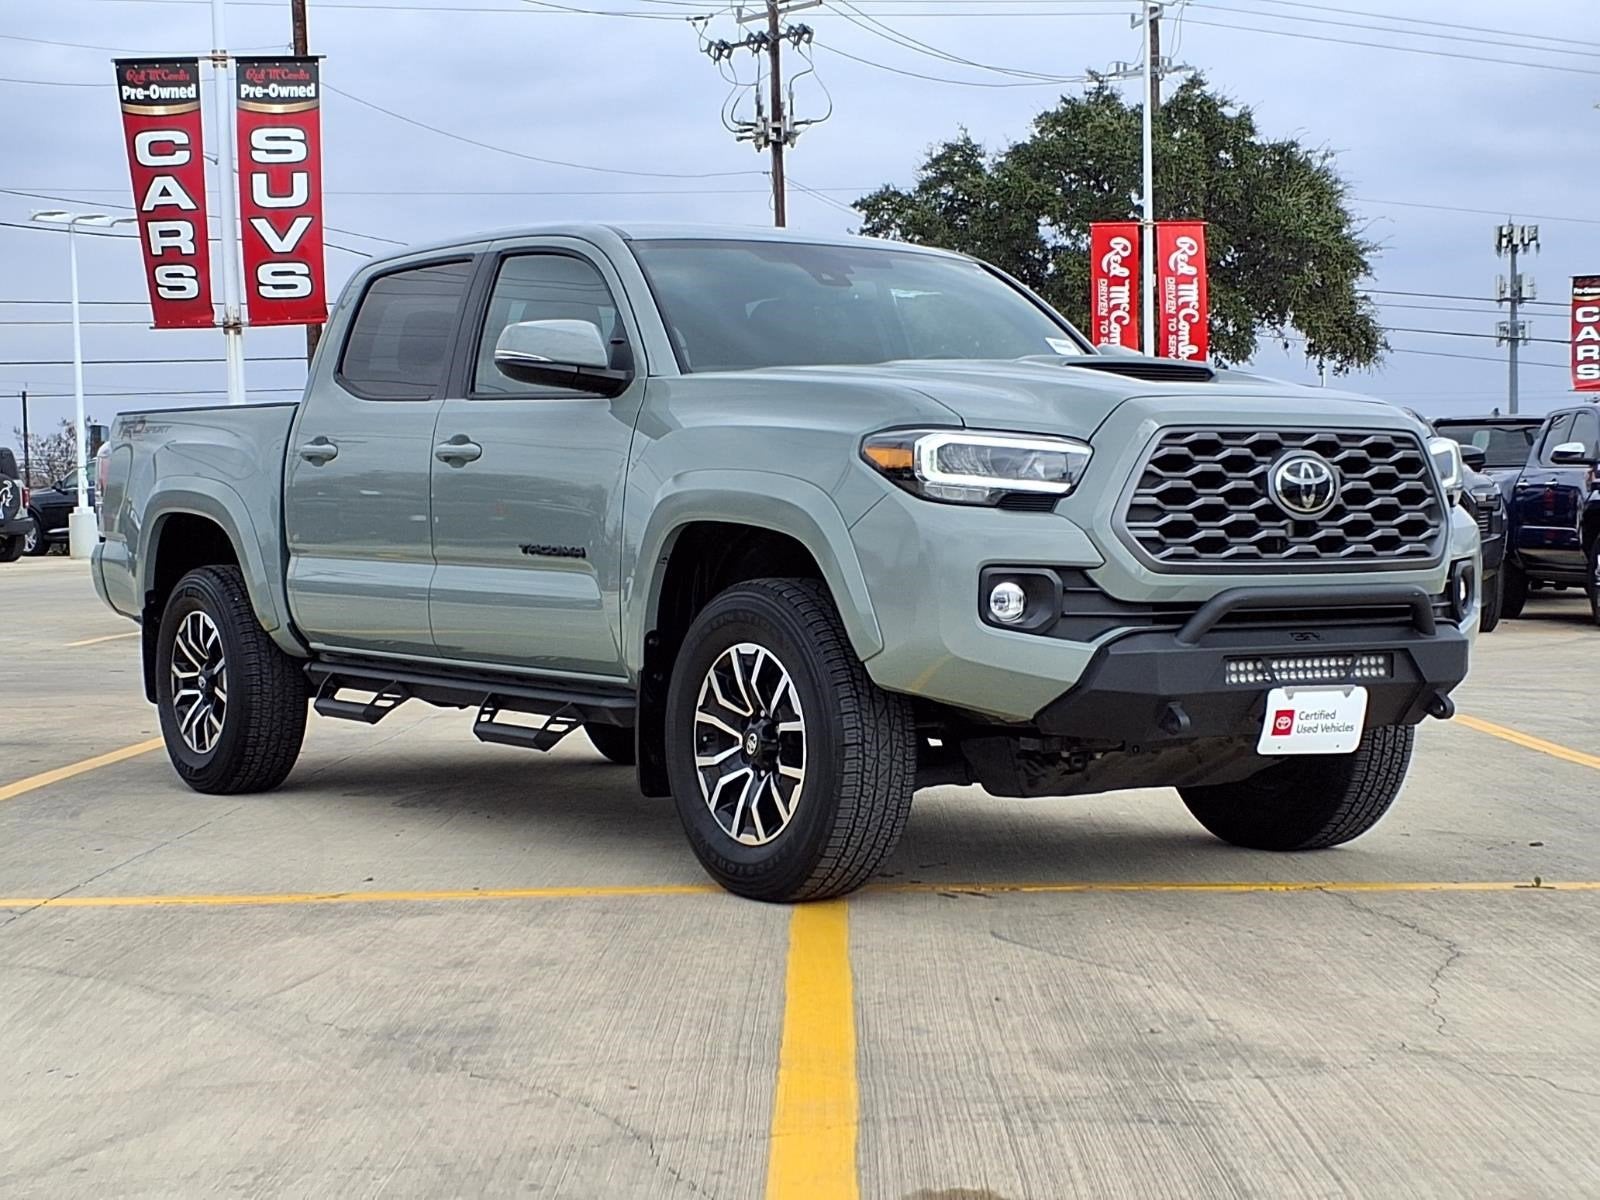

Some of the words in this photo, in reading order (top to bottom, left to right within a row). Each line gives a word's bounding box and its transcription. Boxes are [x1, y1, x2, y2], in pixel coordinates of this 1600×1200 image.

[121, 83, 197, 100] Pre-Owned
[240, 82, 315, 99] Pre-Owned
[134, 130, 199, 299] CARS
[249, 127, 314, 298] SUVS
[1101, 236, 1132, 277] Red
[1168, 236, 1198, 276] Red
[1099, 279, 1108, 316] DRIVEN
[1109, 279, 1130, 346] McCom
[1166, 277, 1176, 314] DRIVEN
[1100, 319, 1109, 334] TO
[1168, 318, 1177, 332] TO
[1575, 306, 1600, 380] CARS
[1168, 334, 1177, 360] SERV
[1296, 722, 1319, 734] Used
[1320, 721, 1355, 733] Vehicles
[1298, 709, 1337, 721] Certified
